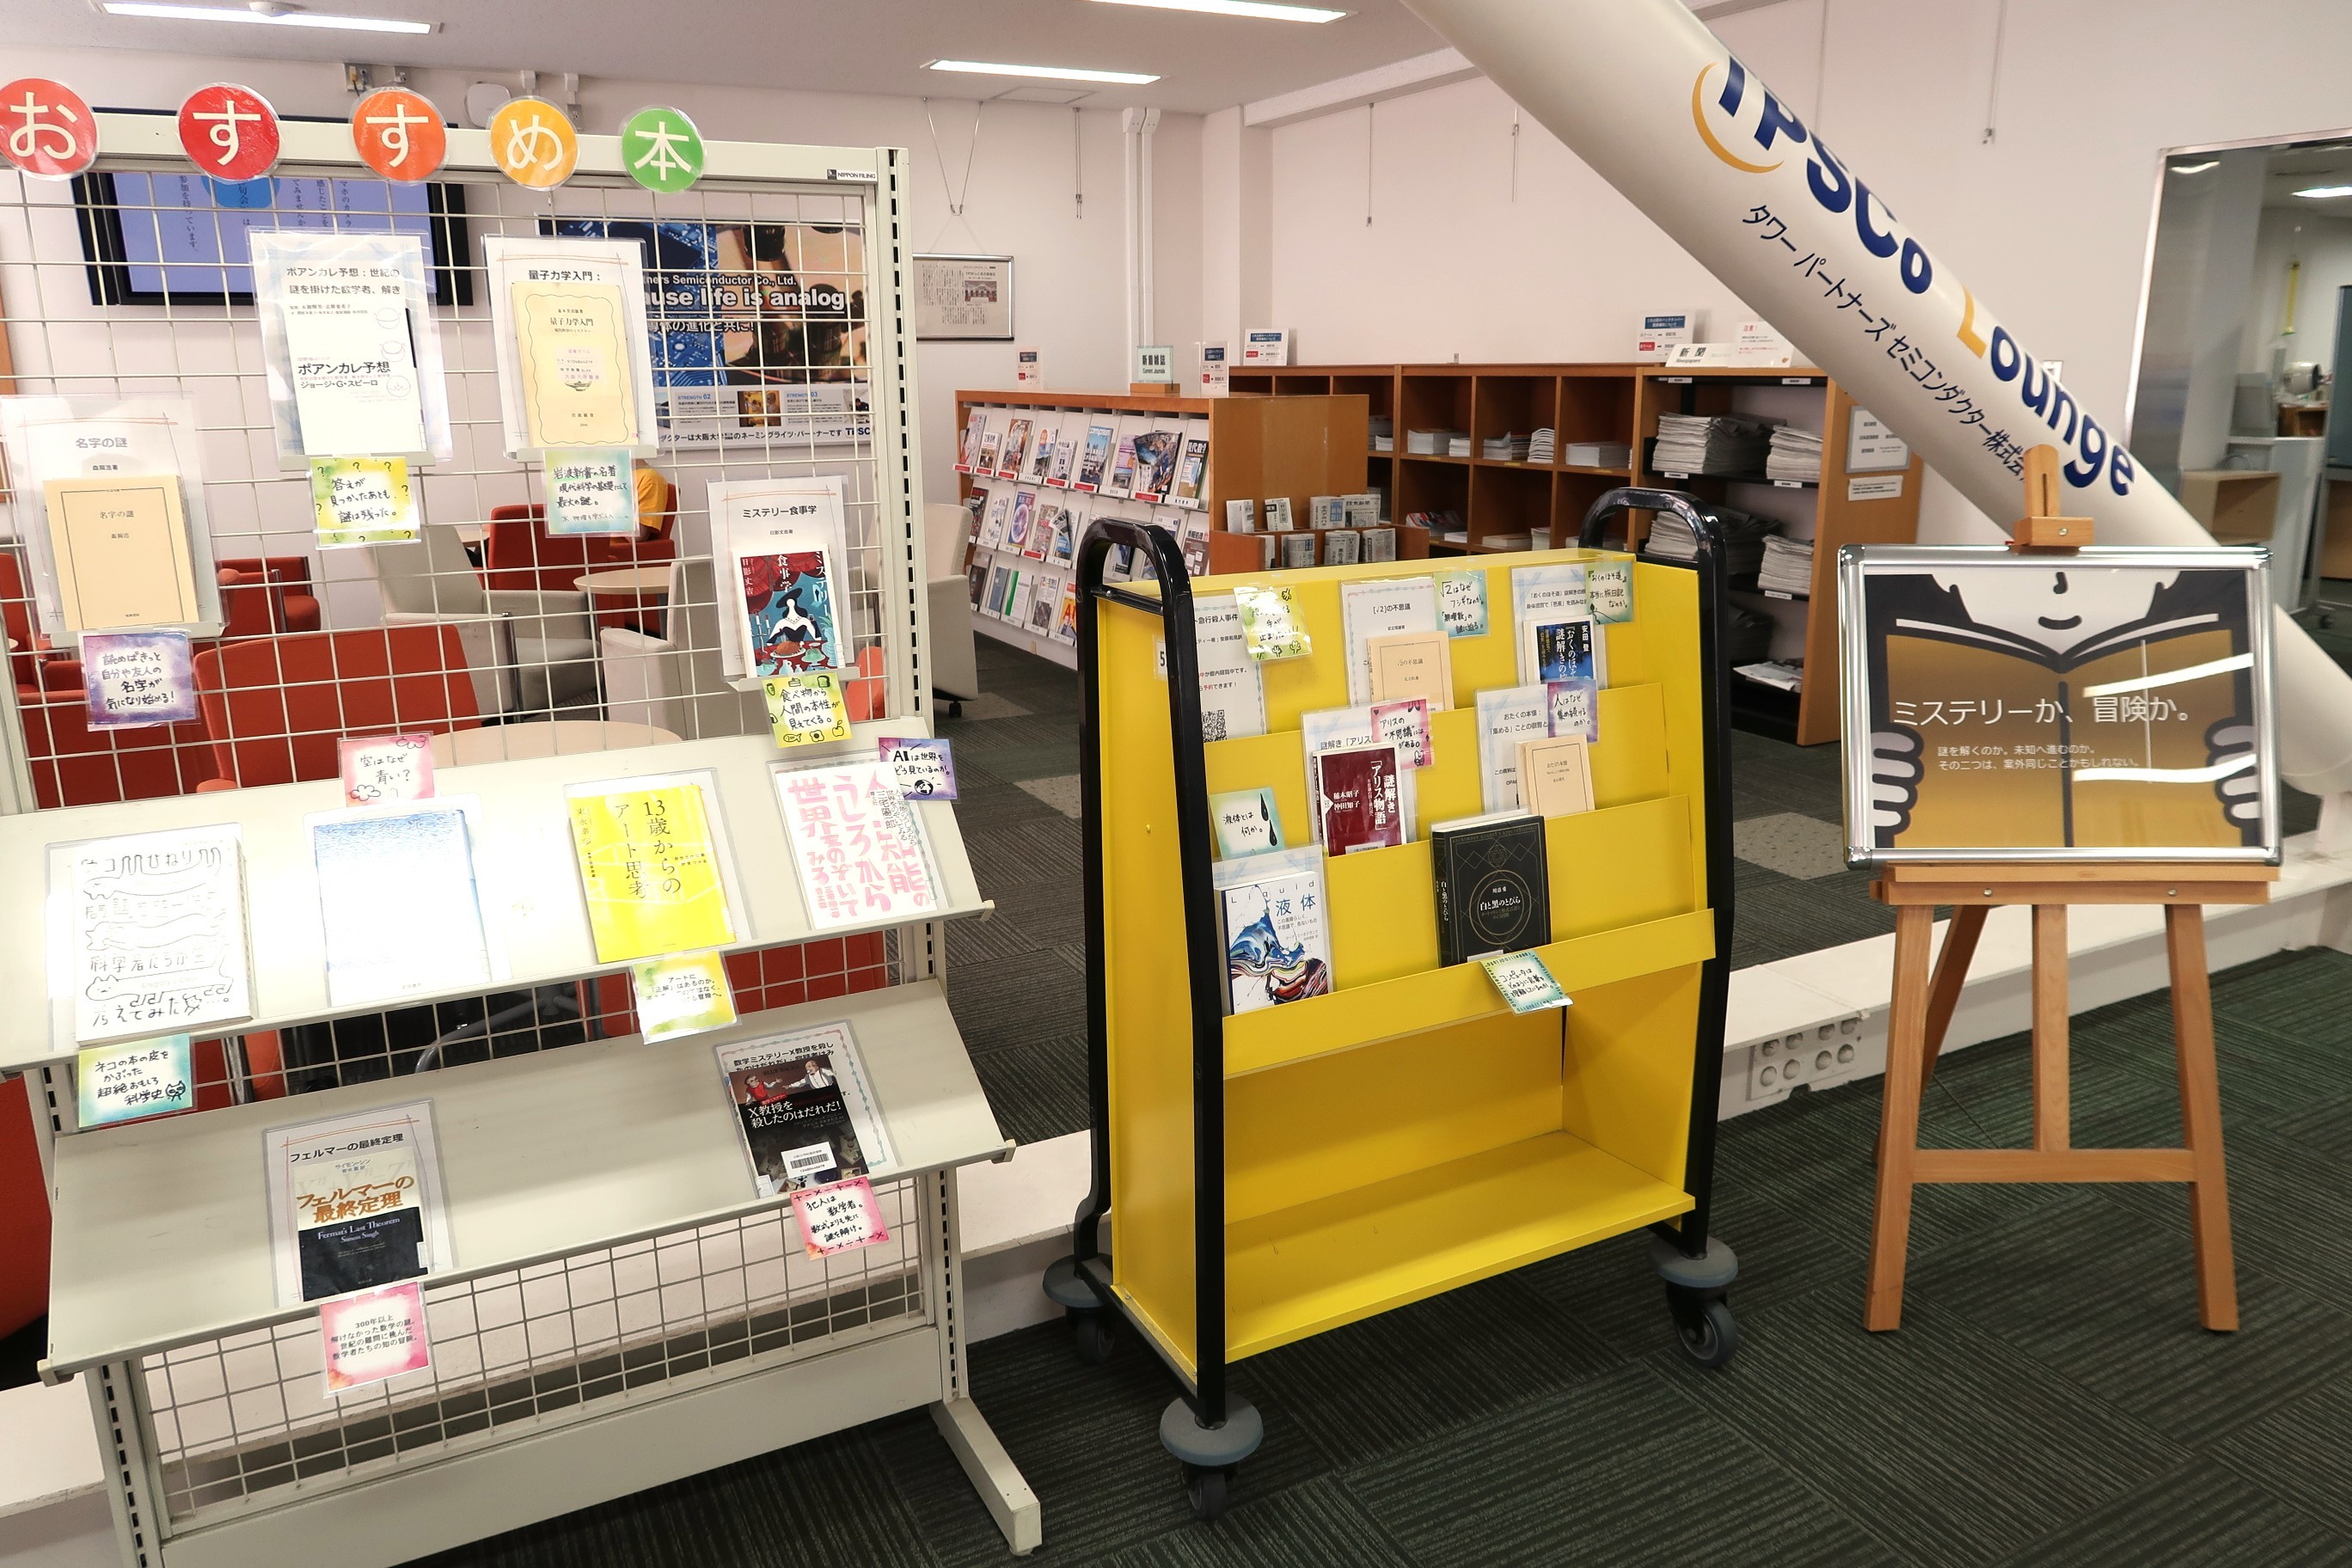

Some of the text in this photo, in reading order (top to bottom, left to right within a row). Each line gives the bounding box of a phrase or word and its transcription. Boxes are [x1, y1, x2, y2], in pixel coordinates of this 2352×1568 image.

[672, 275, 752, 285] Semicnductor
[777, 276, 797, 285] Ltd.
[1742, 205, 1797, 253] タワー
[1793, 252, 1895, 343] パートナーズ
[770, 288, 845, 309] analog
[1679, 346, 1707, 358] 新聞
[1957, 282, 2136, 497] Lounge
[76, 437, 129, 449] 名字の謎
[554, 464, 617, 480] 岩波新書の名著
[331, 477, 366, 492] 答えが
[556, 495, 599, 508] 最大の謎。
[99, 510, 135, 519] 名字の謎
[338, 506, 397, 524] 謎は残った。
[743, 505, 818, 518] ミステリー食事学
[777, 554, 793, 593] 食事学
[815, 551, 829, 616] ミステリー
[101, 651, 162, 666] 読めばきっと
[101, 665, 162, 681] 自分や友人の
[1198, 668, 1247, 678] 中か館内閲覧中です。
[120, 677, 163, 694] 名字が
[780, 687, 827, 702] 食べ物から
[1554, 691, 1583, 707] 人はなぜ
[780, 699, 840, 716] 人間の本性が
[1557, 707, 1587, 721] 集め続ける
[788, 713, 832, 730] 見えてくる。
[1380, 717, 1405, 729] アリスの
[1573, 719, 1590, 727] のか。
[359, 752, 408, 768] 空はなぜ
[893, 750, 945, 763] AIは世界を
[375, 769, 411, 786] 青い？
[894, 764, 950, 776] どう見ているのか。
[1370, 760, 1387, 830] 「アリス物語」
[1383, 775, 1397, 813] 謎解き
[1223, 812, 1254, 825] 液体とは
[1240, 826, 1263, 837] 何か。
[614, 804, 646, 899] アート思考
[643, 799, 681, 894] 13歳からの
[1276, 893, 1316, 917] 液体
[1479, 896, 1521, 911] 白と黒のとびら
[668, 973, 696, 983] アートに
[95, 1049, 169, 1072] ネコの本の皮を
[102, 1067, 144, 1083] かぶった
[96, 1078, 160, 1099] 超絶おもしろ
[124, 1087, 165, 1106] 科学史
[747, 1100, 793, 1118] X教授を
[750, 1100, 842, 1129] 殺したのはだれだ！
[290, 1133, 404, 1163] フェルマーの最終定理
[297, 1175, 414, 1209] フェルマーの
[313, 1191, 403, 1223] 最終定理
[805, 1195, 837, 1211] 犯人は
[827, 1199, 863, 1217] 数学者。
[318, 1216, 401, 1240] Fermat's Last Theorem
[824, 1224, 863, 1243] 謎を解け。
[340, 1229, 380, 1244] Simon Singh
[355, 1314, 395, 1329] 300年以上
